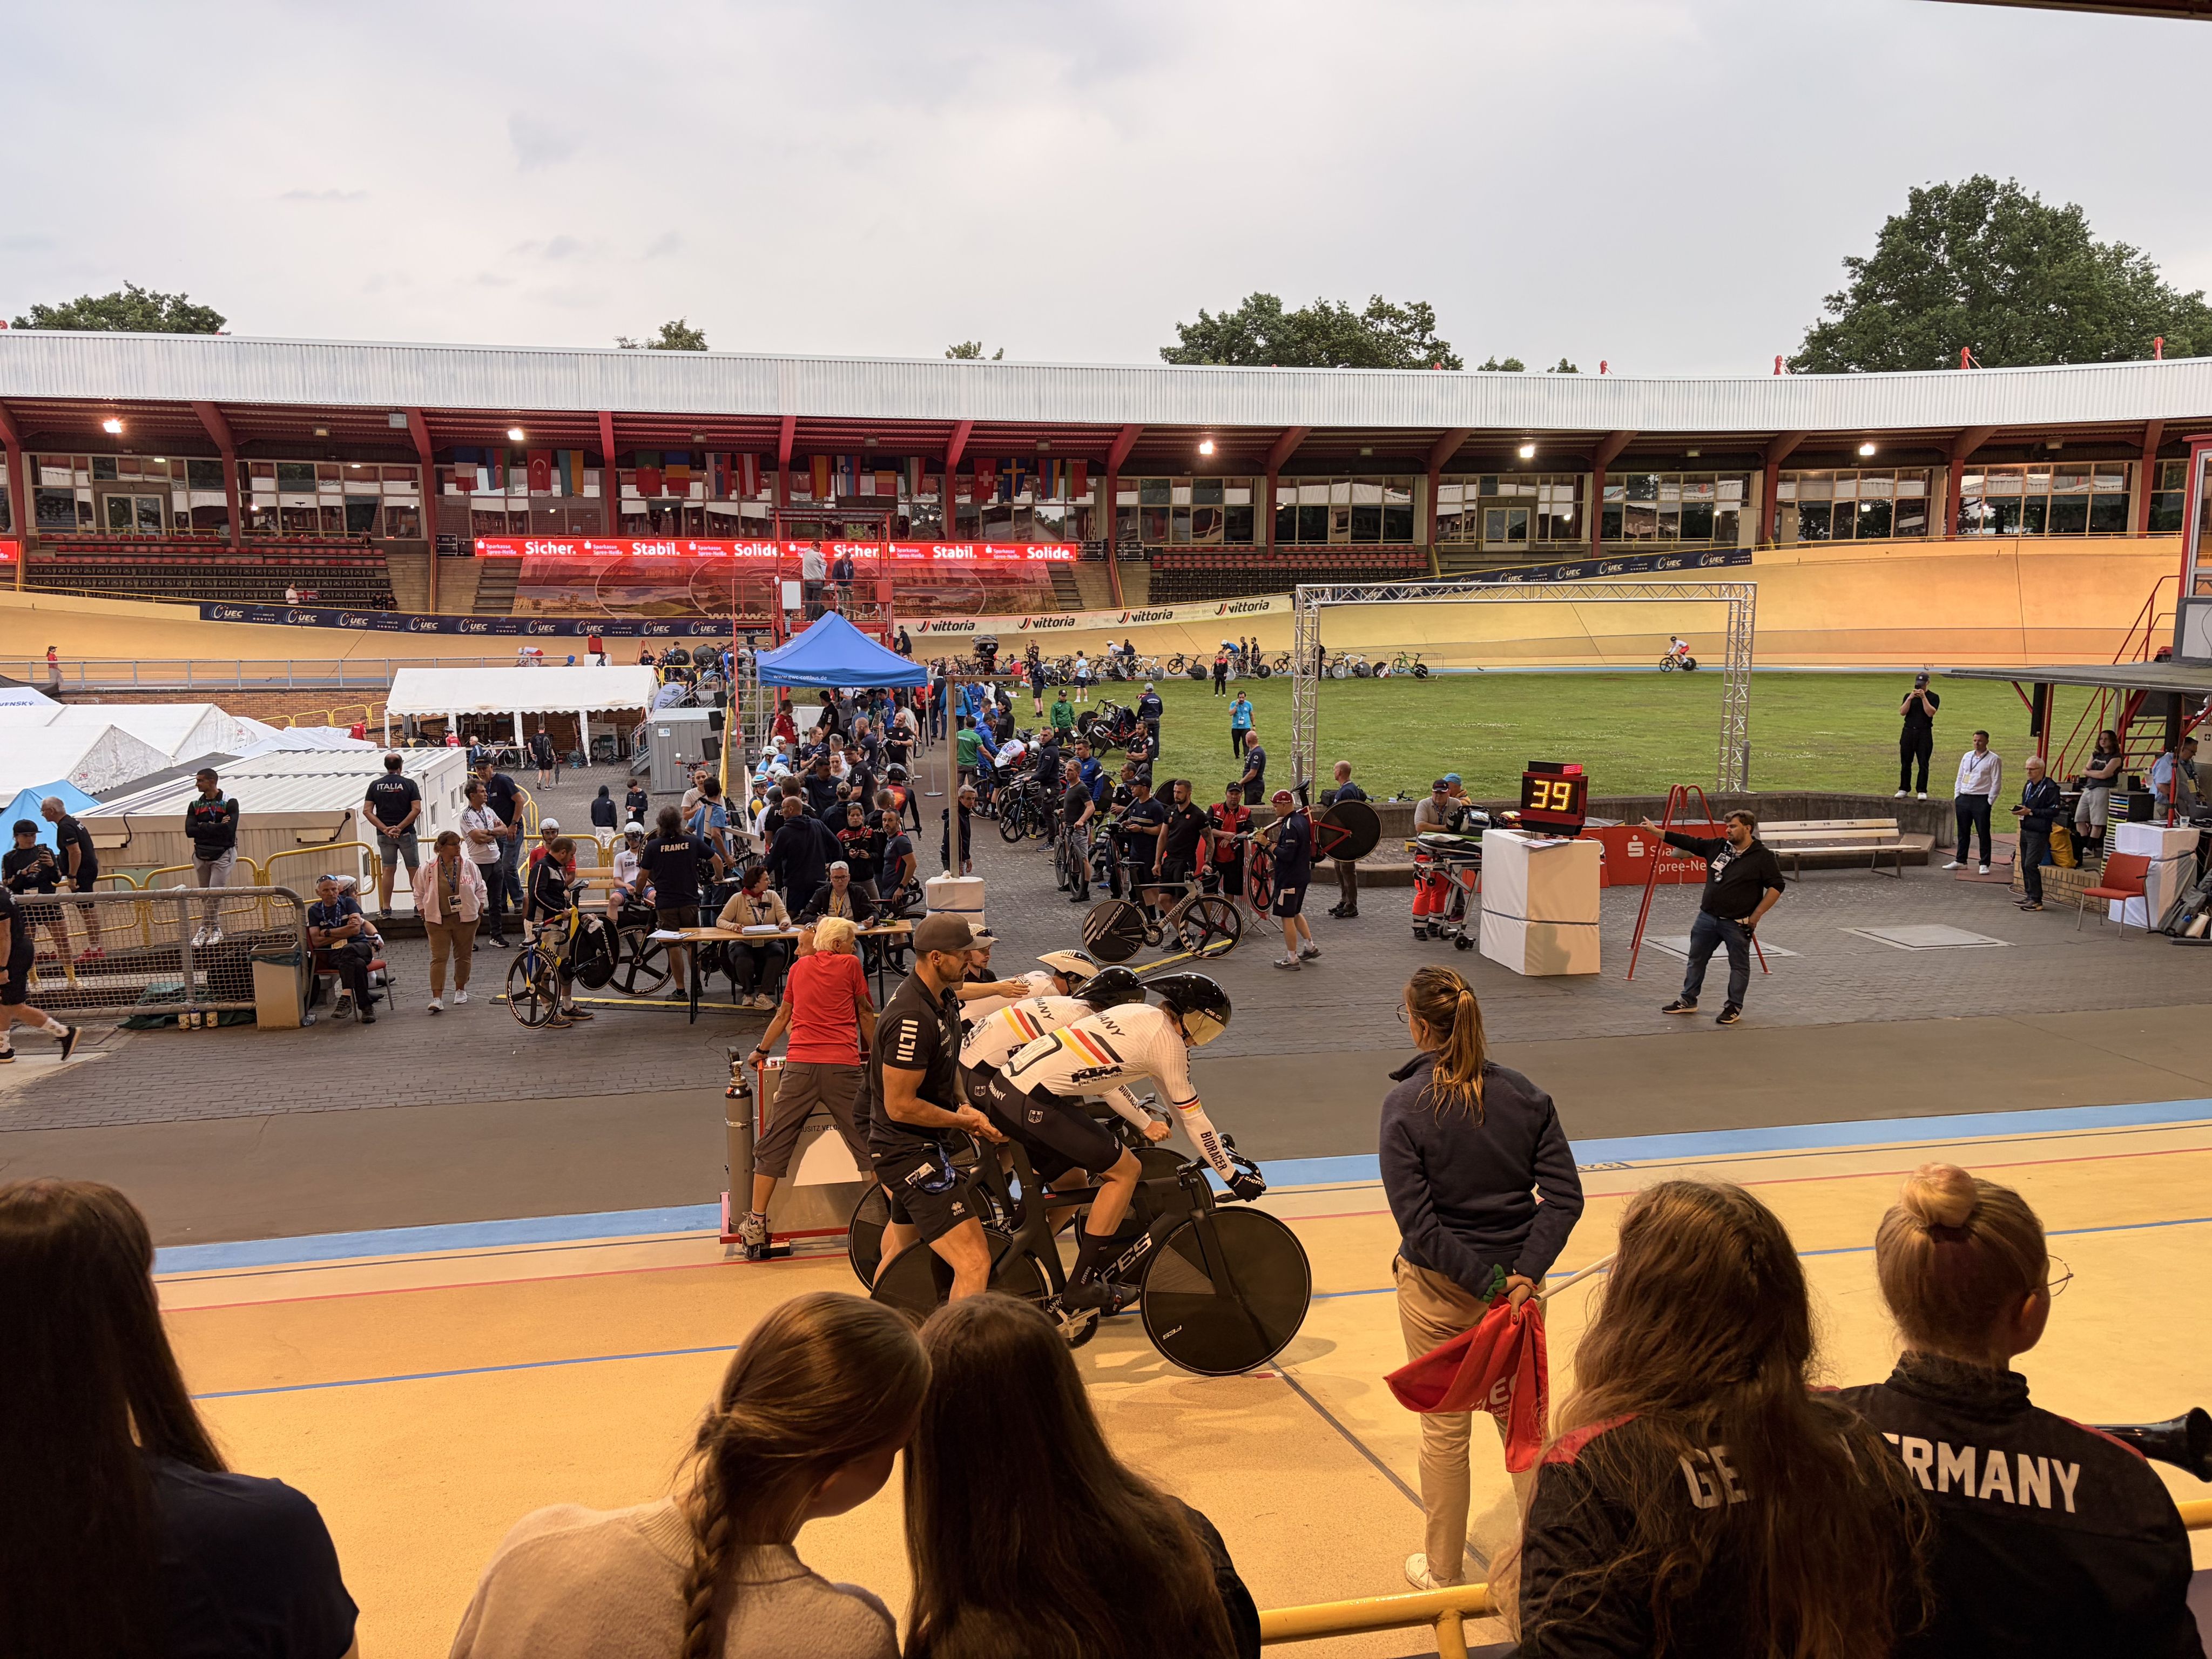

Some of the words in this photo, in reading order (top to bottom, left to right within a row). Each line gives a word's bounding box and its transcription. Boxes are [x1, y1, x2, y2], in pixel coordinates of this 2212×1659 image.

[525, 541, 576, 555] Sicher.
[632, 542, 680, 555] Stabil.
[734, 543, 785, 556] Solide.
[933, 545, 977, 558] Stabil.
[1027, 547, 1074, 559] Solide.
[1228, 599, 1270, 613] vittoria
[1033, 616, 1075, 629] vittoria
[1131, 609, 1173, 622] vittoria
[932, 620, 975, 632] vittoria
[1530, 779, 1572, 811] 39
[660, 842, 689, 852] FRANCE
[1651, 860, 1707, 875] pree-Ne
[1162, 896, 1191, 926] HANDSLING
[1095, 904, 1124, 941] CORIMA
[1118, 1084, 1141, 1112] BIORACER
[1200, 1131, 1228, 1171] BIORACER
[1102, 1231, 1153, 1289] FES
[1163, 1325, 1182, 1340] FES
[1883, 1433, 2080, 1513] RMANY
